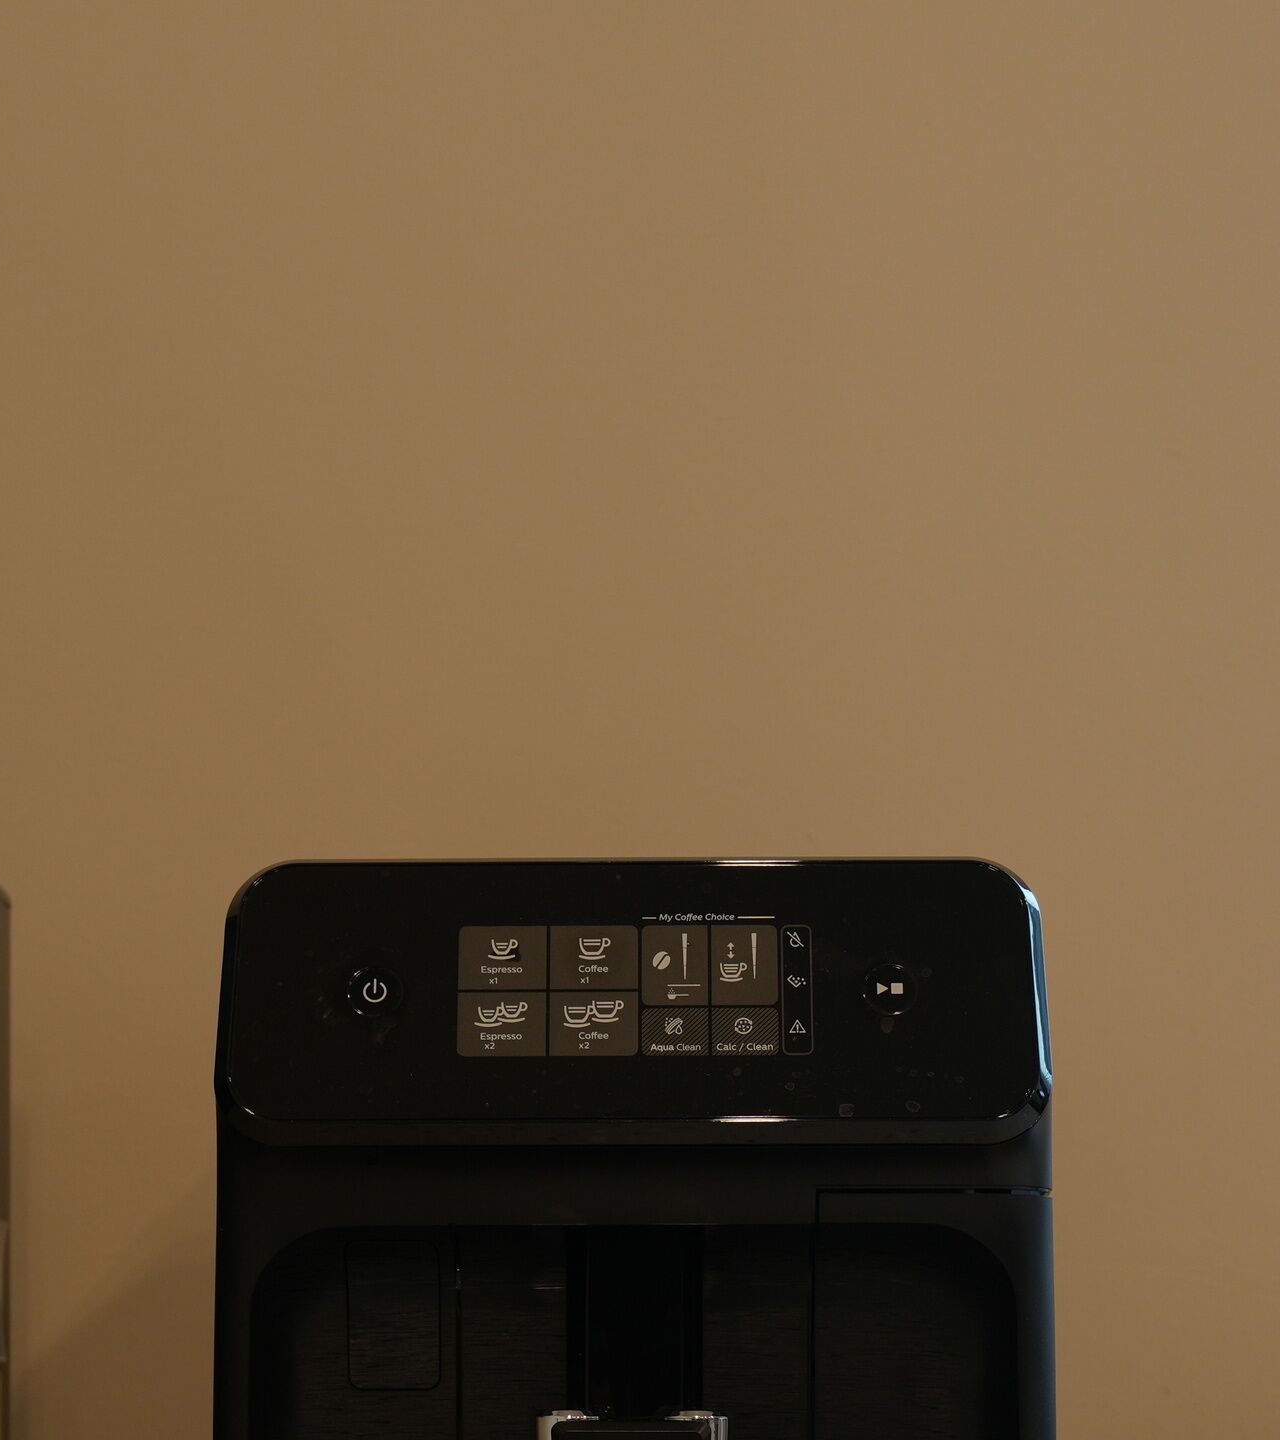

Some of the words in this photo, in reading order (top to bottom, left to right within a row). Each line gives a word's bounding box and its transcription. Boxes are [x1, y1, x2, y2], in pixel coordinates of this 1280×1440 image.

[659, 913, 673, 923] My
[675, 913, 703, 922] Coffee
[705, 913, 735, 921] Choice
[480, 965, 523, 975] Espresso
[578, 965, 609, 973] Coffee
[480, 1032, 523, 1042] Espresso
[578, 1031, 609, 1040] Coffee
[650, 1043, 674, 1053] Aqua
[676, 1043, 702, 1051] Clean
[716, 1043, 737, 1051] Calc
[746, 1043, 774, 1051] Clean
